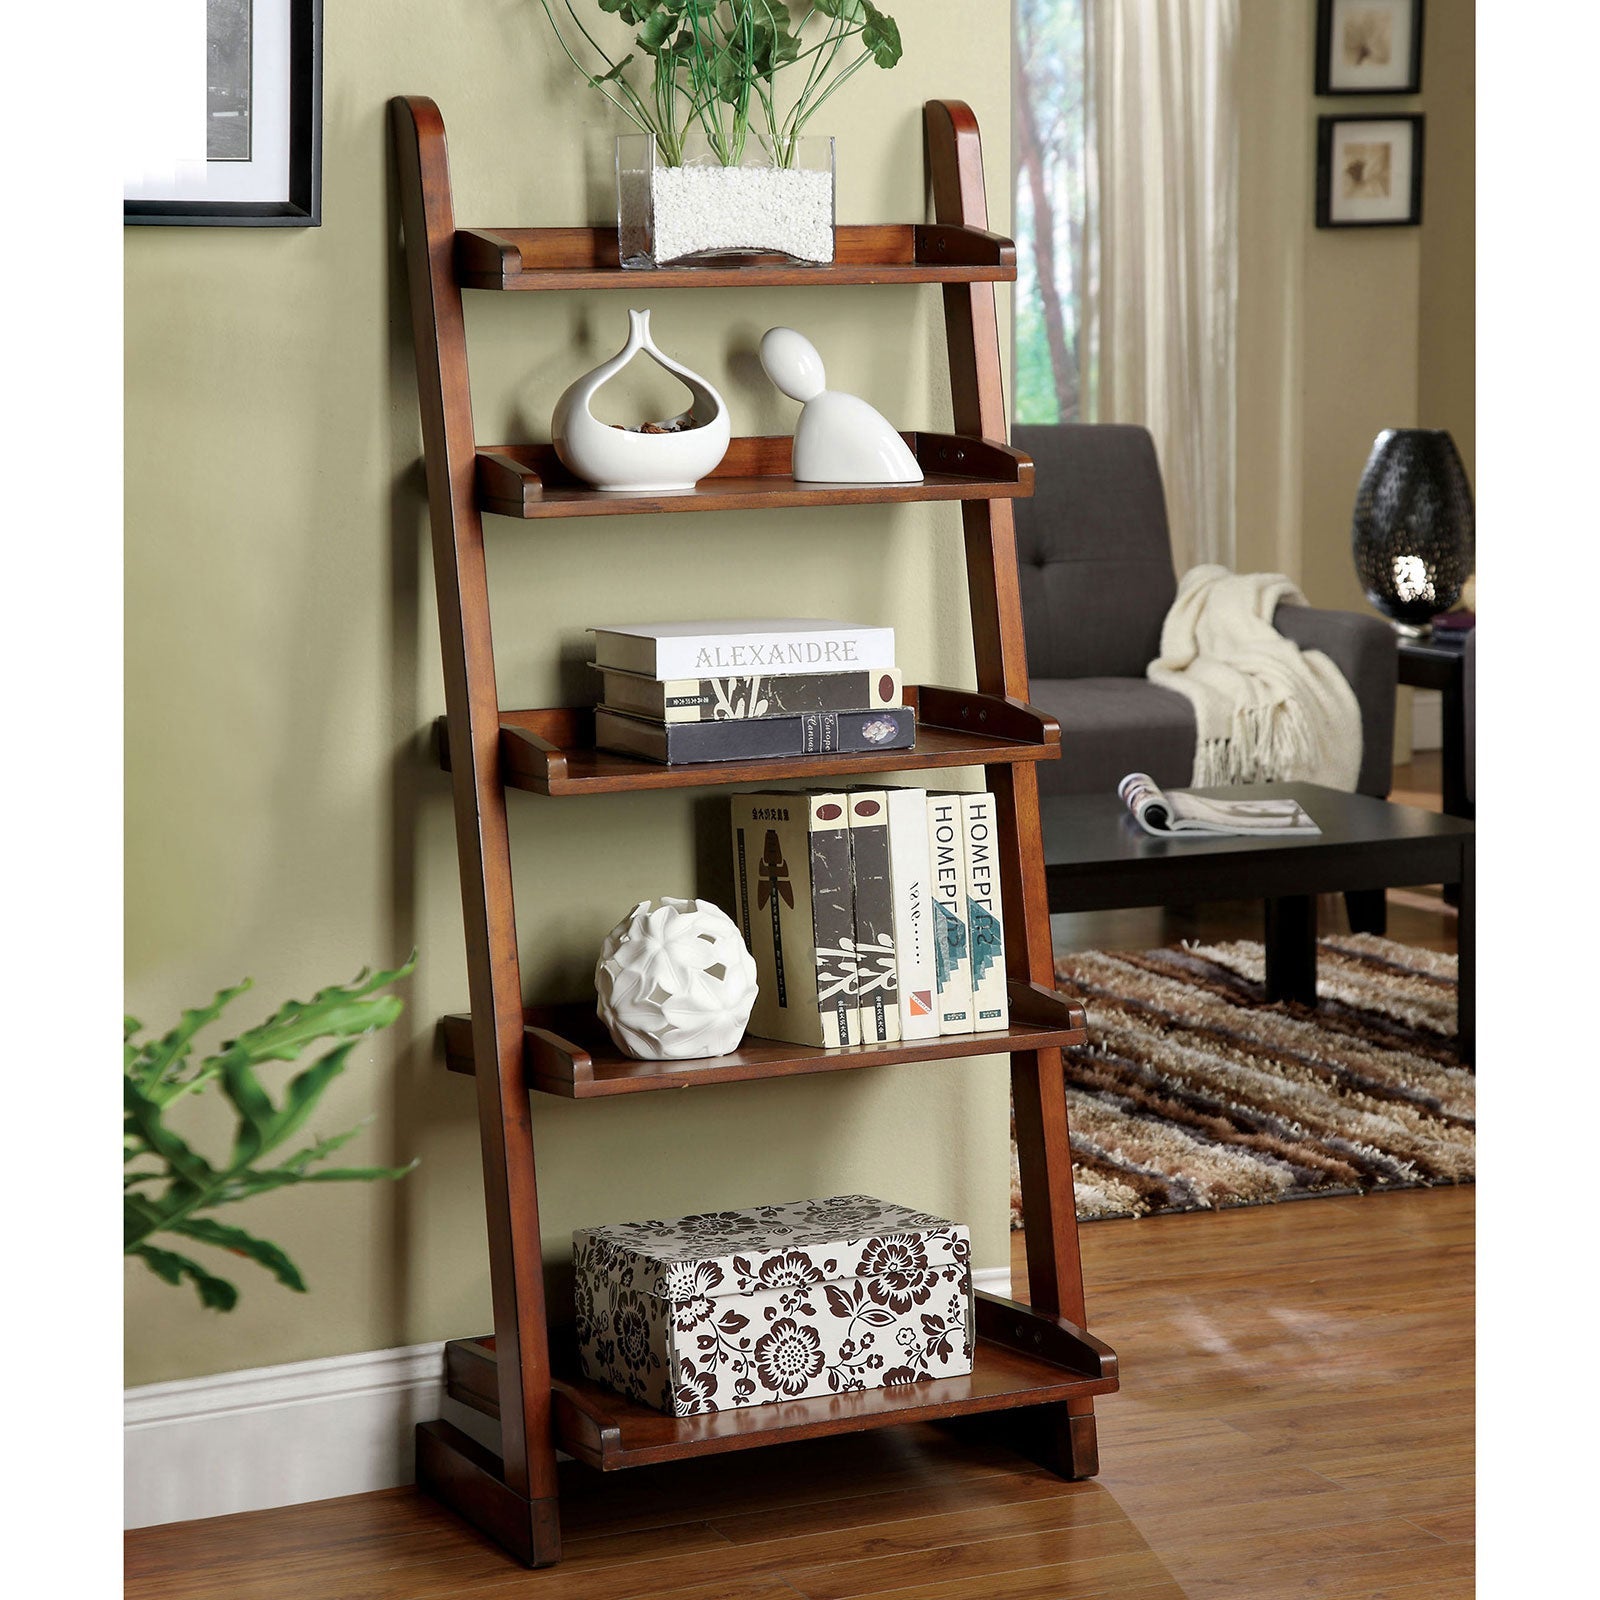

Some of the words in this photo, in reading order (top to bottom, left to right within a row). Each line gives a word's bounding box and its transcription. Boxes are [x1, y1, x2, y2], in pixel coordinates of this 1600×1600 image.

[695, 640, 859, 668] ALEXANDRE
[807, 715, 818, 752] Canvas
[823, 714, 834, 751] Europe
